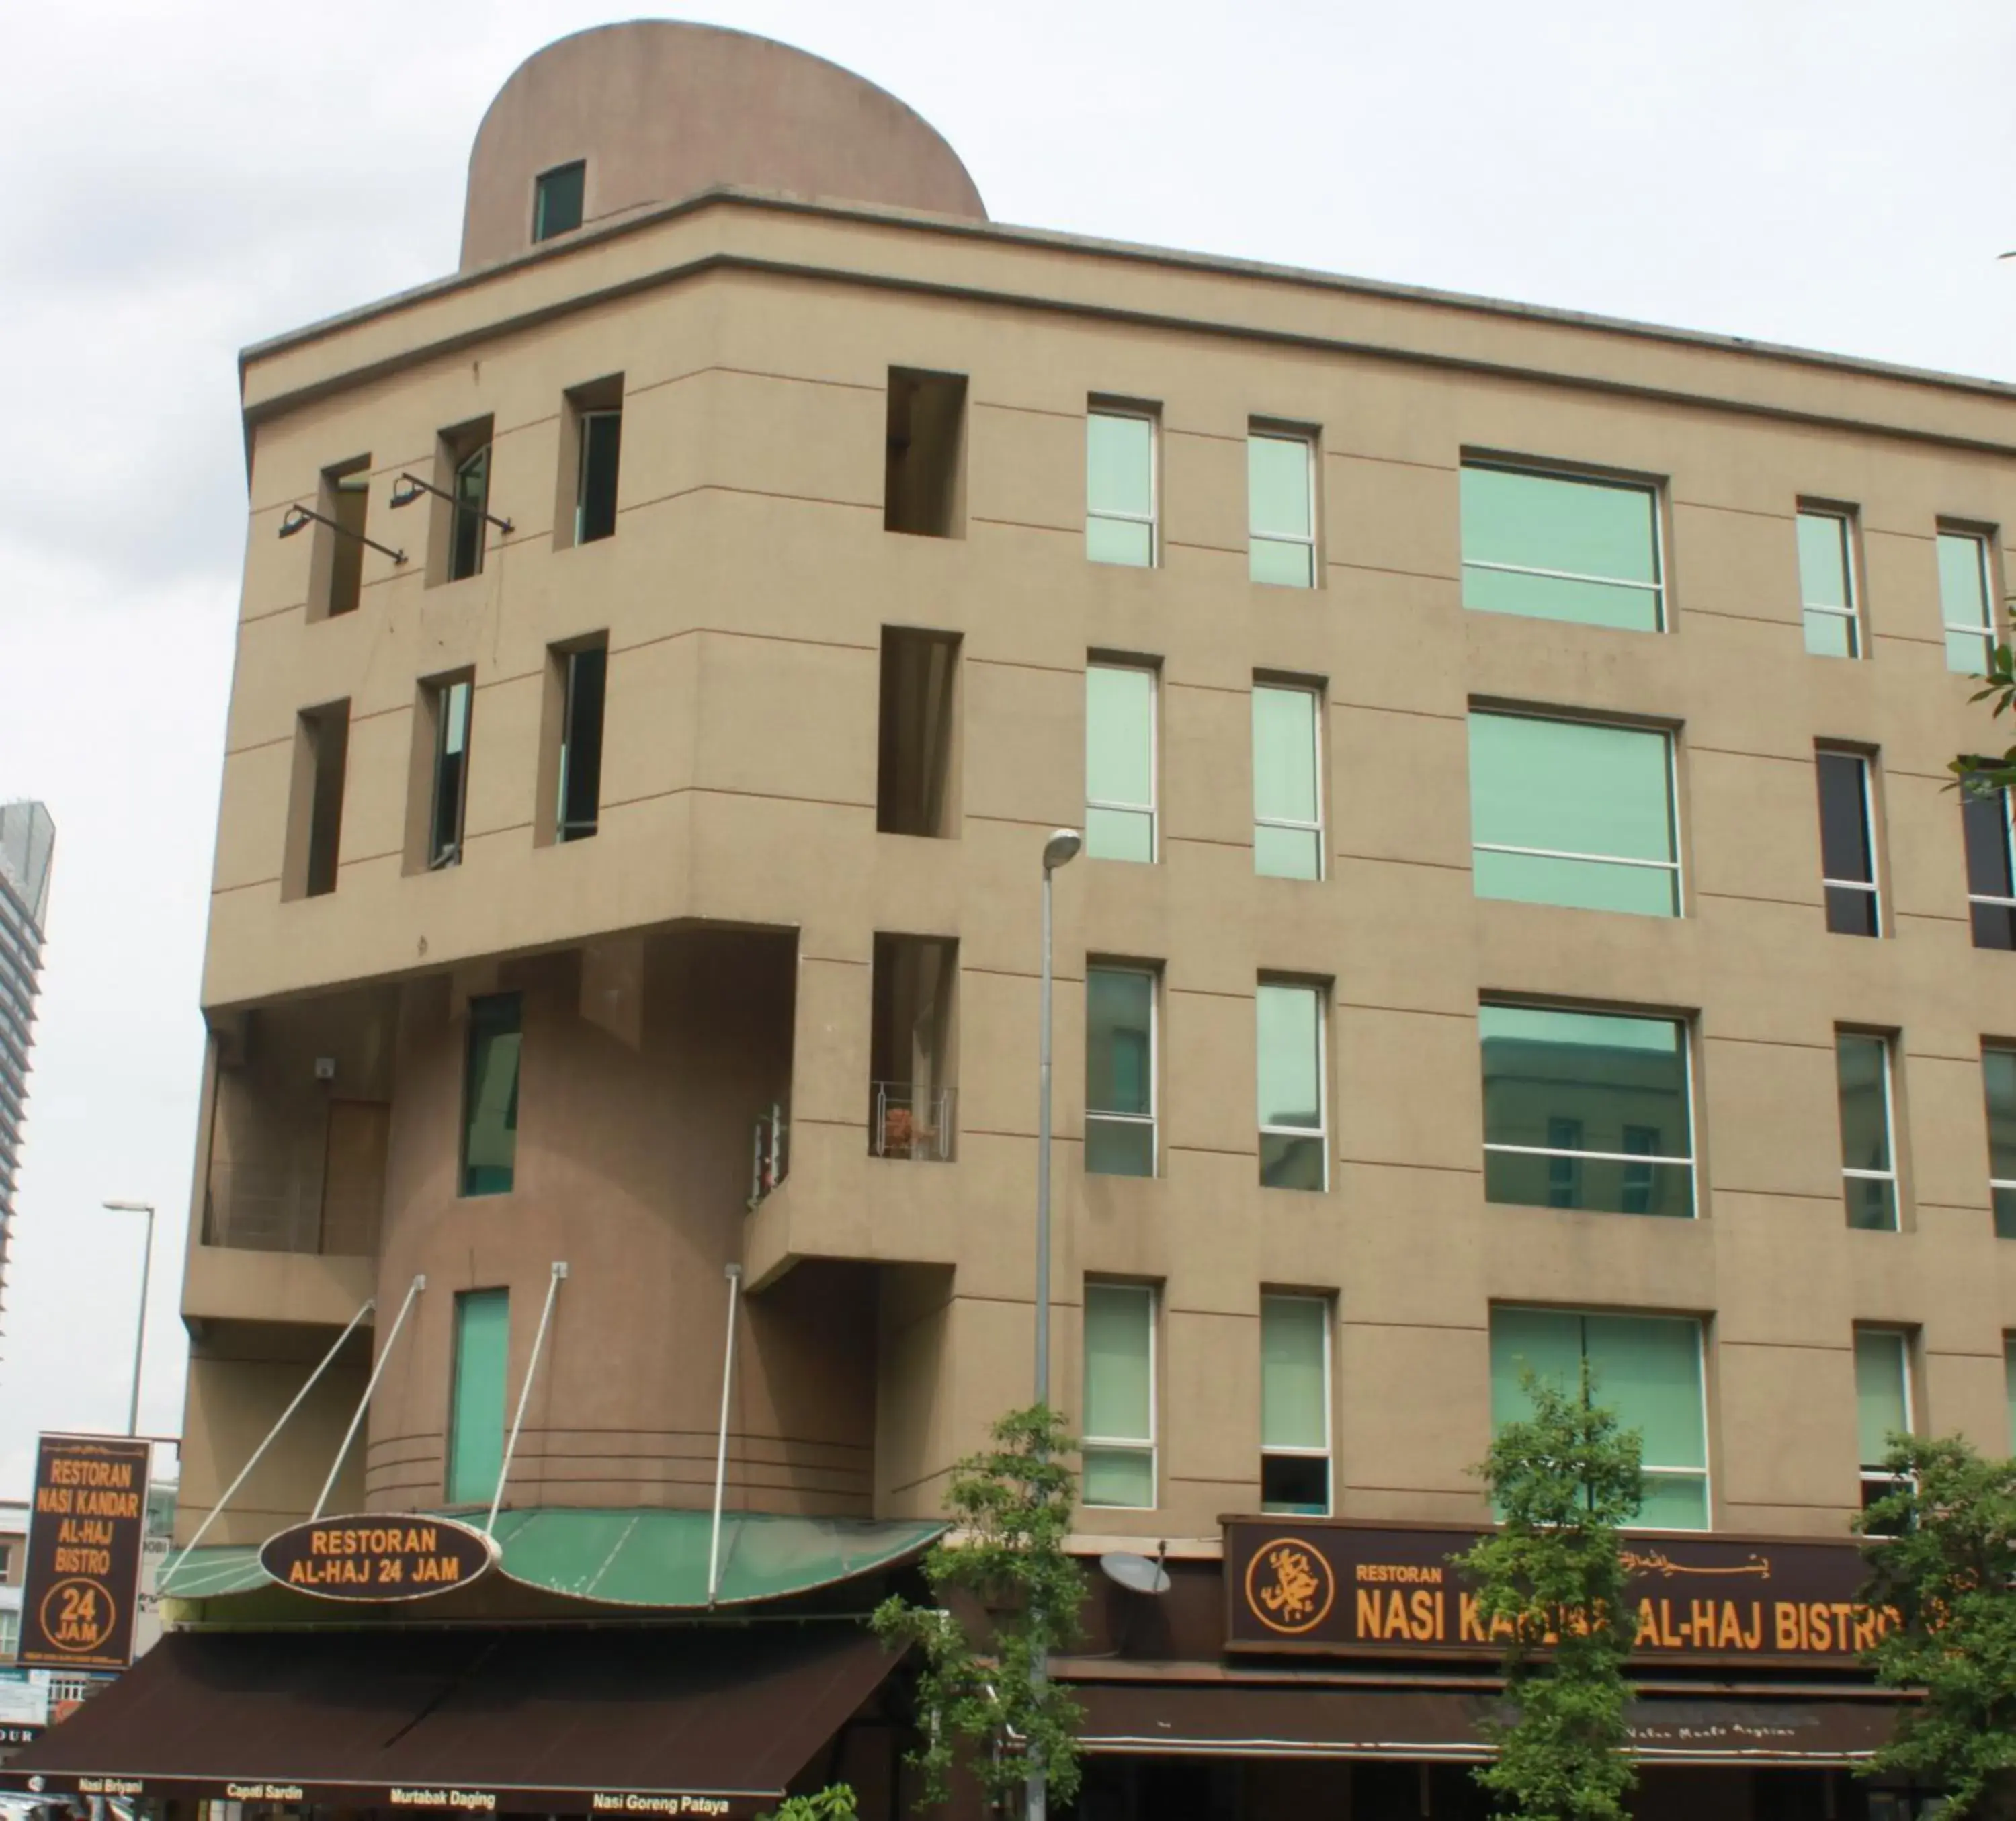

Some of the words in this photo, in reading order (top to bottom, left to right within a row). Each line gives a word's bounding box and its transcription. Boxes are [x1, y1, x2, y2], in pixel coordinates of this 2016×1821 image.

[51, 1459, 131, 1486] RESTORAN
[38, 1488, 73, 1513] NASI
[77, 1490, 139, 1518] KANDAR
[59, 1519, 113, 1543] AL-HAJ
[311, 1528, 437, 1554] RESTORAN
[55, 1548, 110, 1574] BISTRO
[290, 1558, 370, 1584] AL-HAJ
[378, 1558, 403, 1583] 24
[411, 1556, 460, 1582] JAM
[1356, 1565, 1441, 1584] RESTORAN
[60, 1588, 95, 1620] 24
[55, 1621, 97, 1641] JAM
[1356, 1589, 1445, 1640] NASI
[1634, 1598, 1762, 1650] AL-HAJ
[79, 1778, 103, 1793] Nasi
[104, 1779, 143, 1797] Briyani
[227, 1783, 263, 1799] Capati
[265, 1785, 303, 1799] Sardin
[390, 1787, 448, 1805] Murtabak
[450, 1790, 496, 1810] Daging
[593, 1793, 624, 1809] Nasi
[626, 1794, 678, 1814] Goreng
[681, 1796, 729, 1816] Pataya
